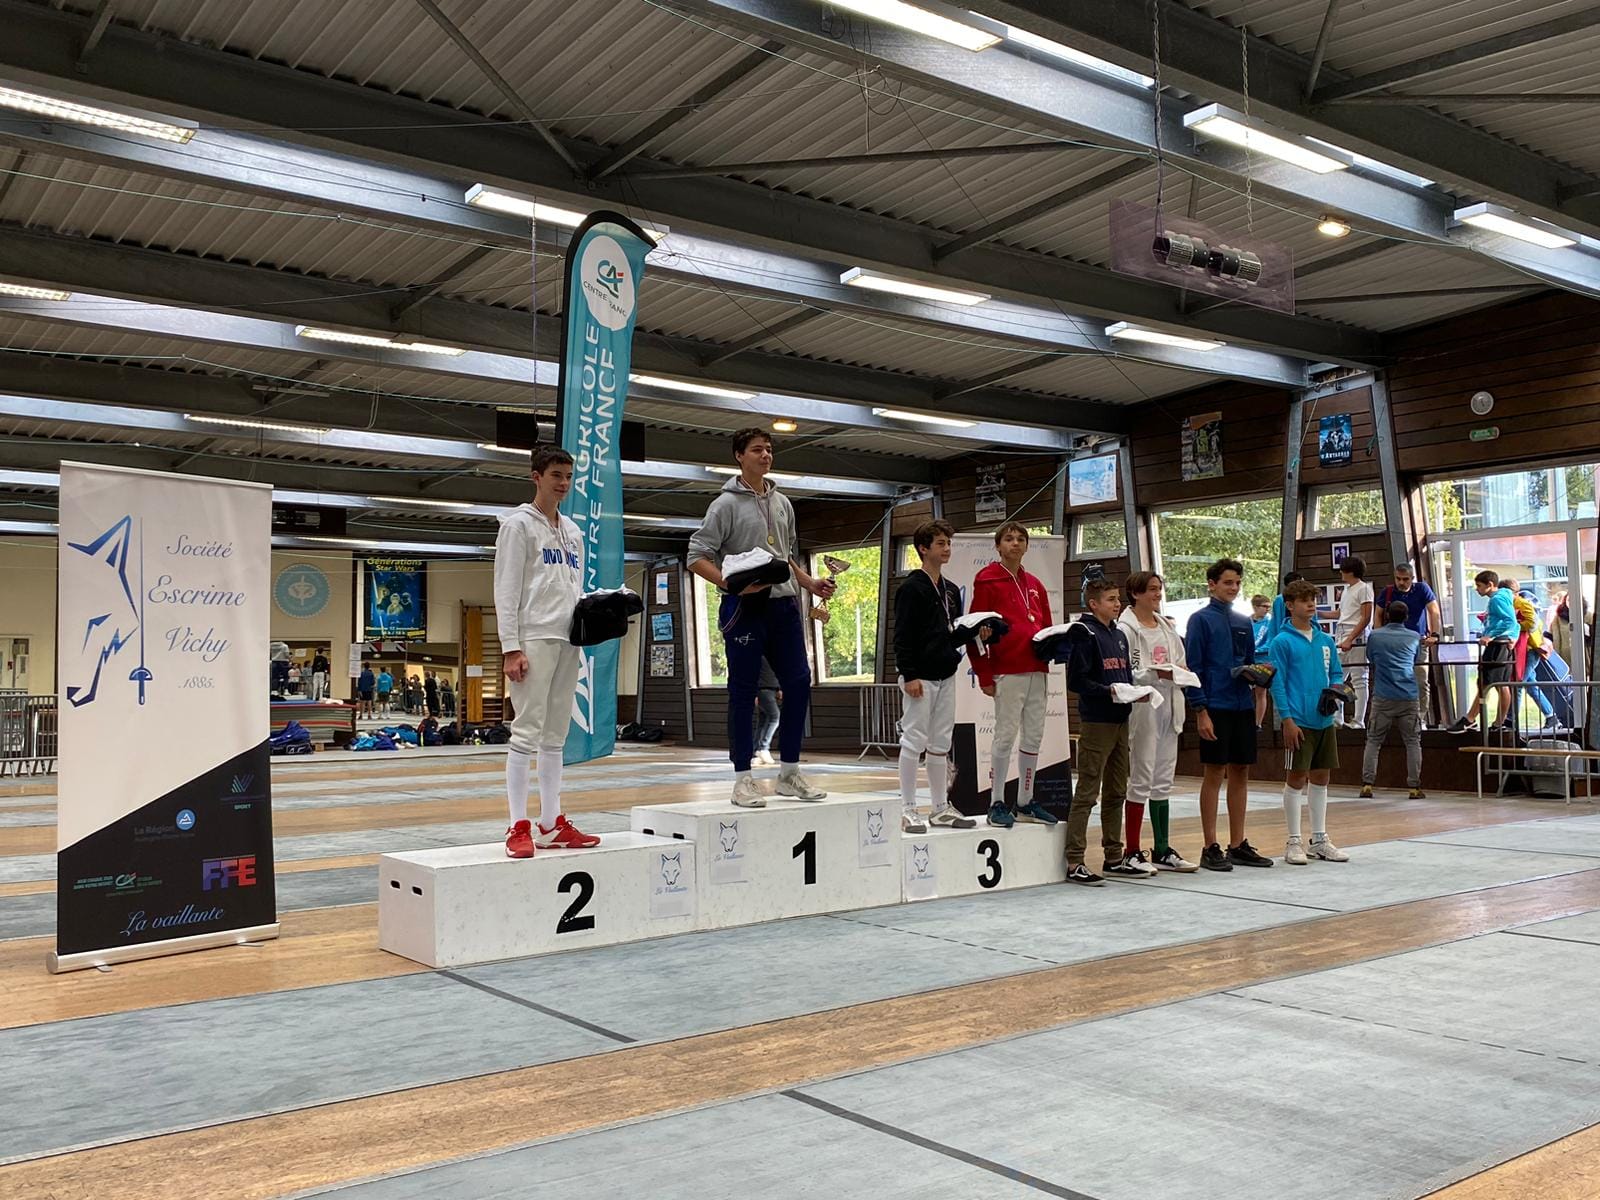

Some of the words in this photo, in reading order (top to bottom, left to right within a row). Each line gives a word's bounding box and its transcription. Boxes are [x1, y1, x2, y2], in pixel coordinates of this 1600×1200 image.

[166, 534, 233, 559] Société
[148, 574, 247, 607] Escrime
[165, 627, 232, 663] Vichy
[202, 857, 257, 891] FFE
[792, 830, 817, 885] 1
[977, 838, 1002, 889] 3
[556, 871, 595, 934] 2
[120, 910, 147, 937] La
[152, 904, 224, 930] vaillante
